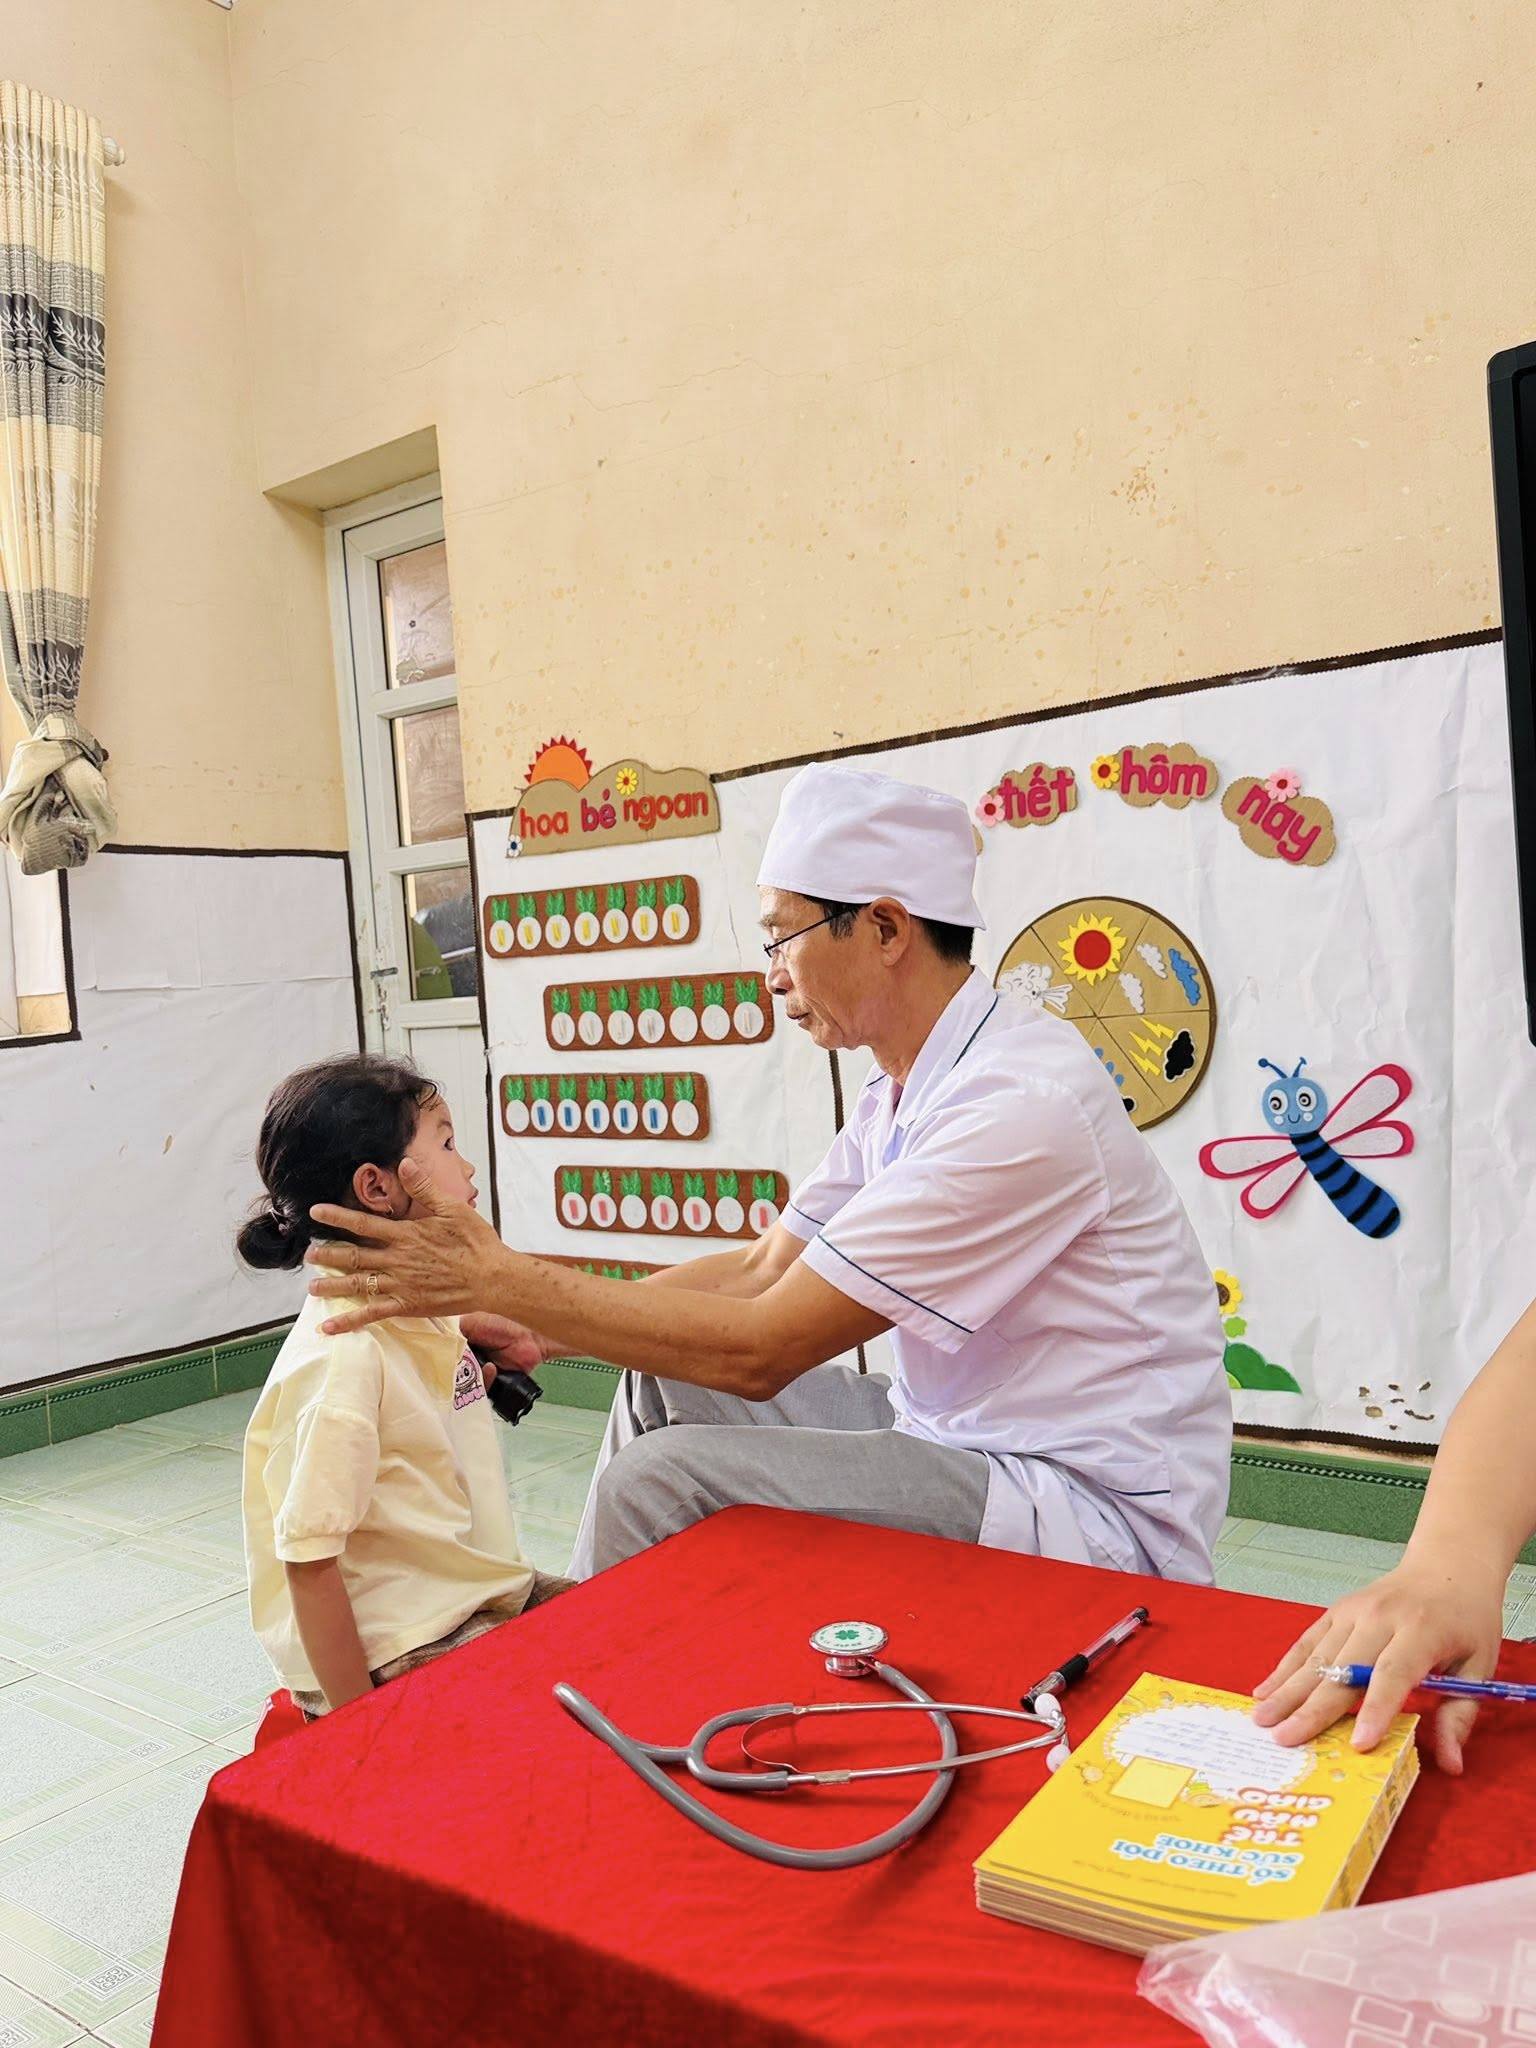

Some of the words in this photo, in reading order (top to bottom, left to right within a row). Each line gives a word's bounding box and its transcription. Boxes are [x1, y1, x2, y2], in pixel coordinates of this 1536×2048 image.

[519, 807, 569, 839] hoa
[580, 788, 618, 833] bé
[623, 791, 709, 830] ngoan
[1000, 765, 1075, 821] tiết
[1120, 750, 1208, 796] hôm
[1237, 783, 1323, 863] nay
[1238, 1787, 1333, 1810] GIÁO
[1170, 1855, 1245, 1876] THEO
